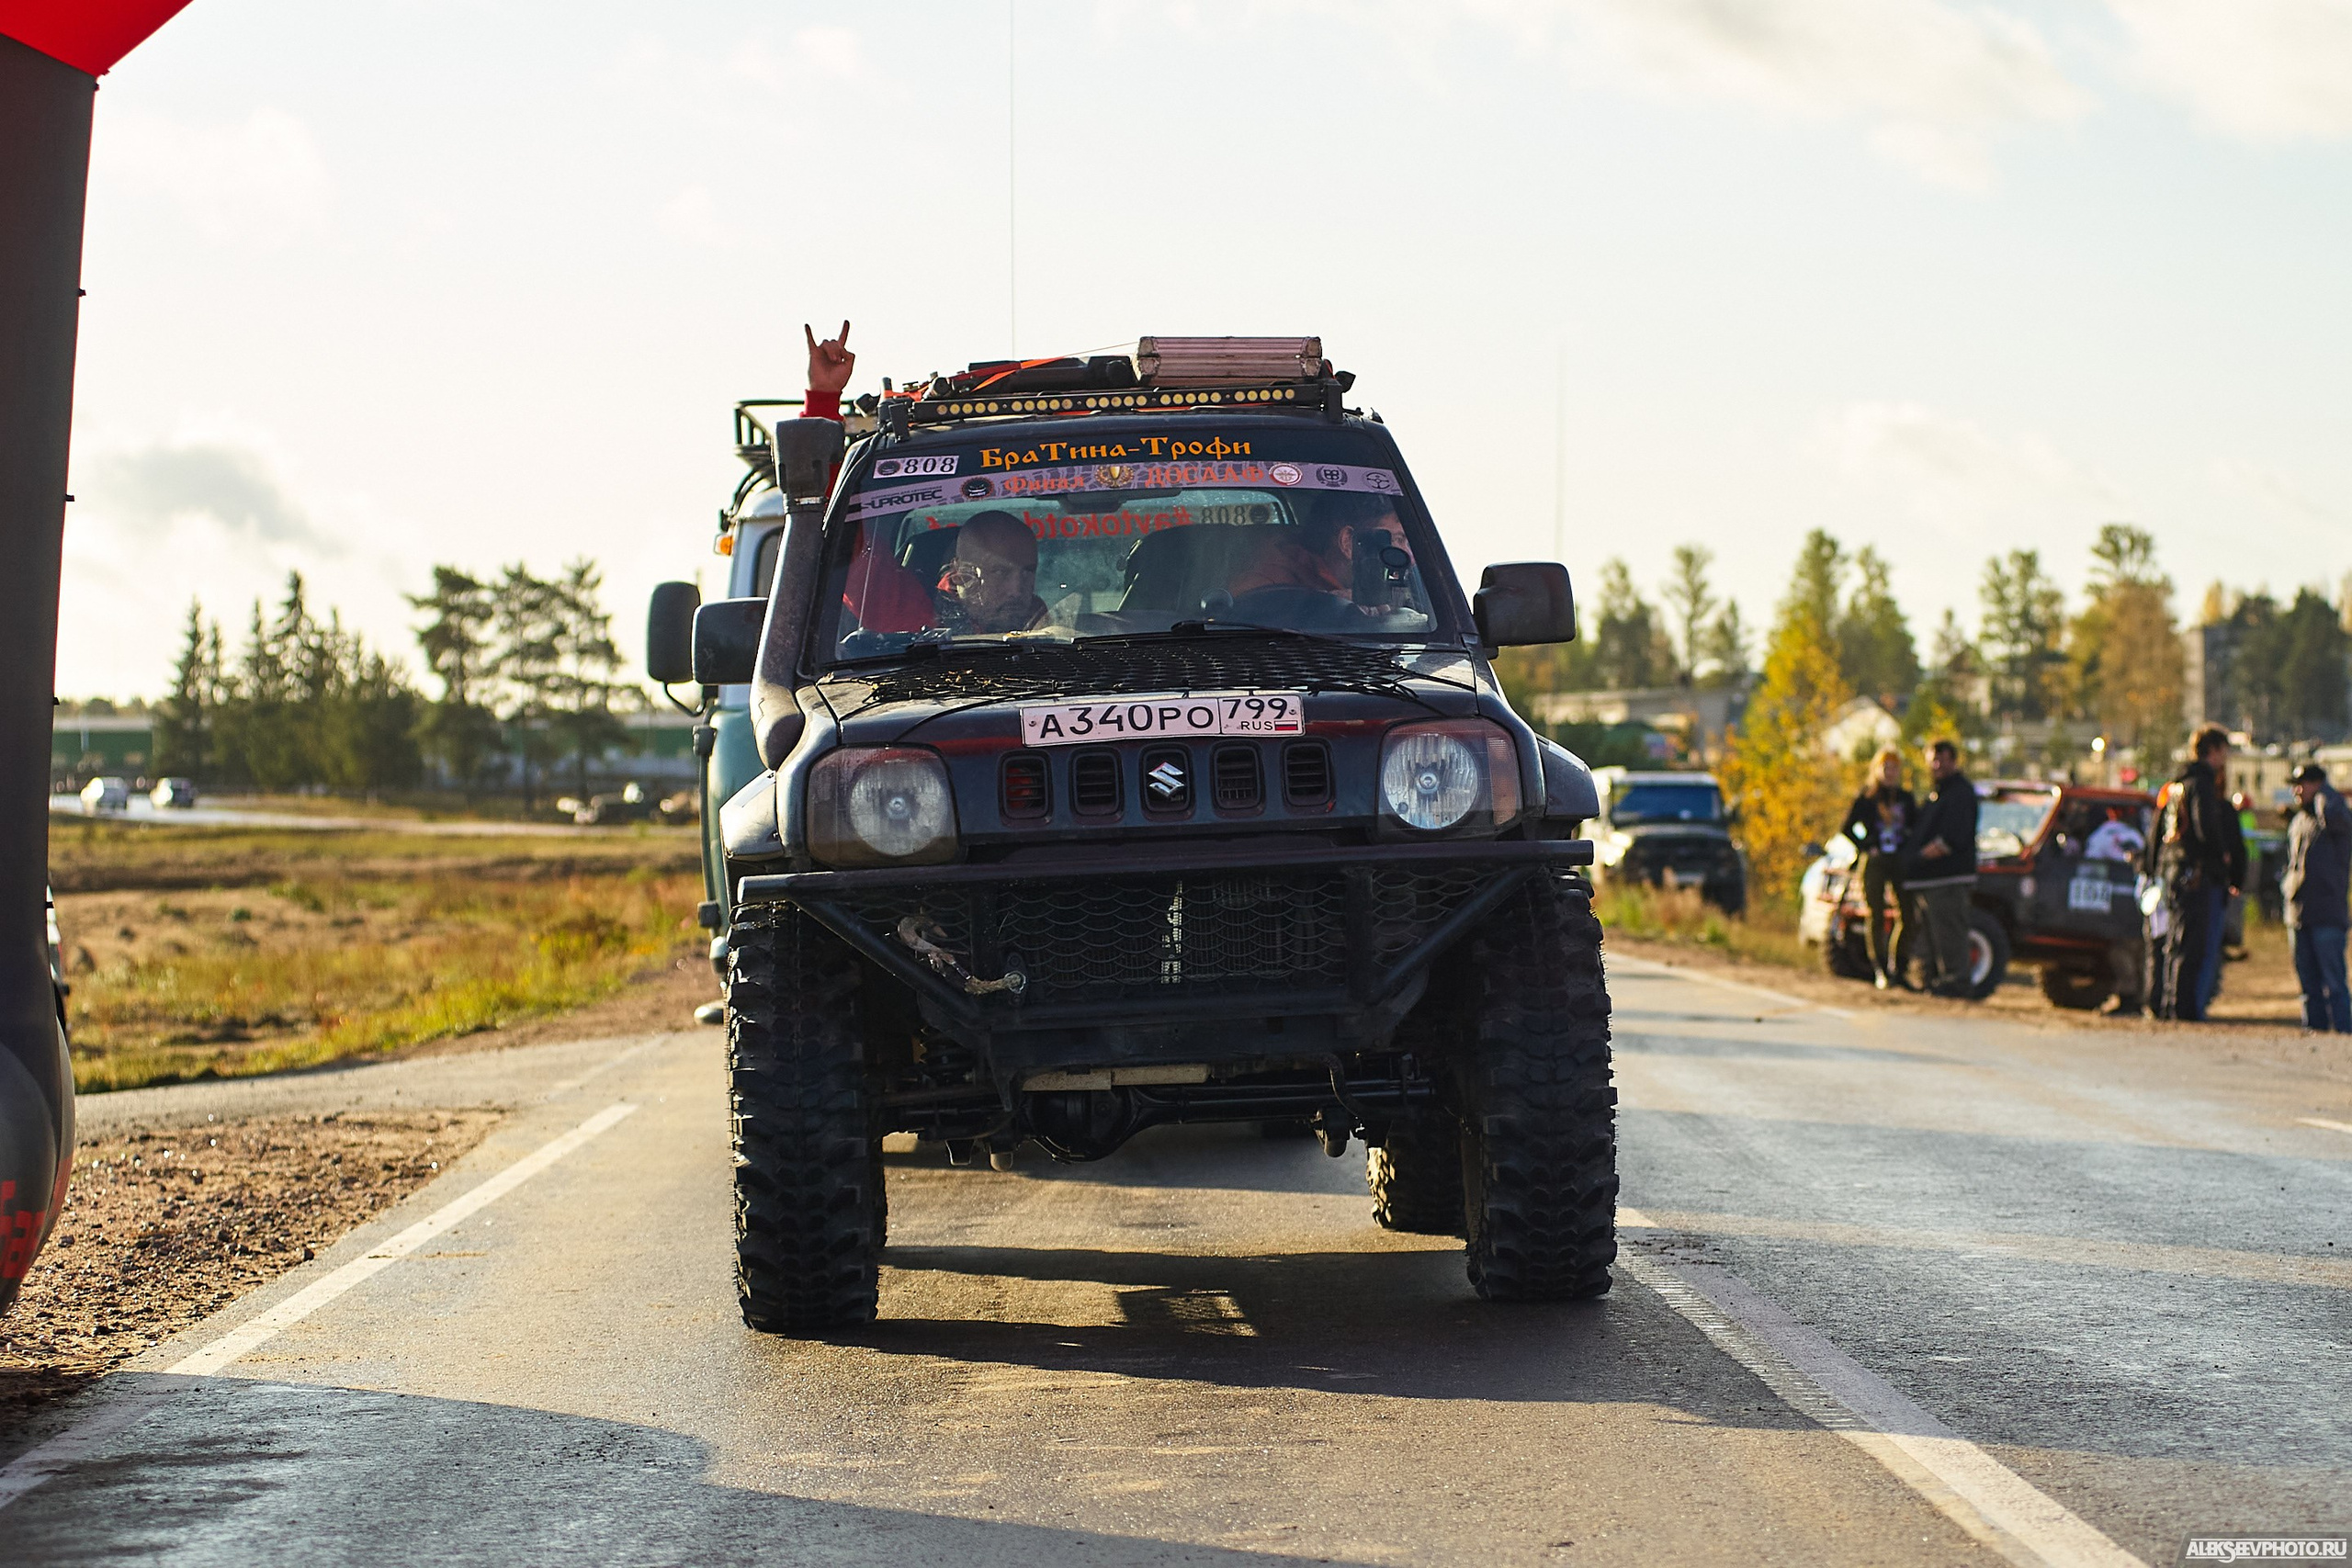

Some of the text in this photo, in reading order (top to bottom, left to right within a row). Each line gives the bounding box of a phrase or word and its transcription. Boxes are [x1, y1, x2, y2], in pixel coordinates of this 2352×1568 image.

[904, 457, 955, 474] 808
[1003, 475, 1084, 493] Финал
[1144, 466, 1265, 488] ДОСААФ
[1222, 698, 1288, 720] 799
[1240, 720, 1273, 731] RUS
